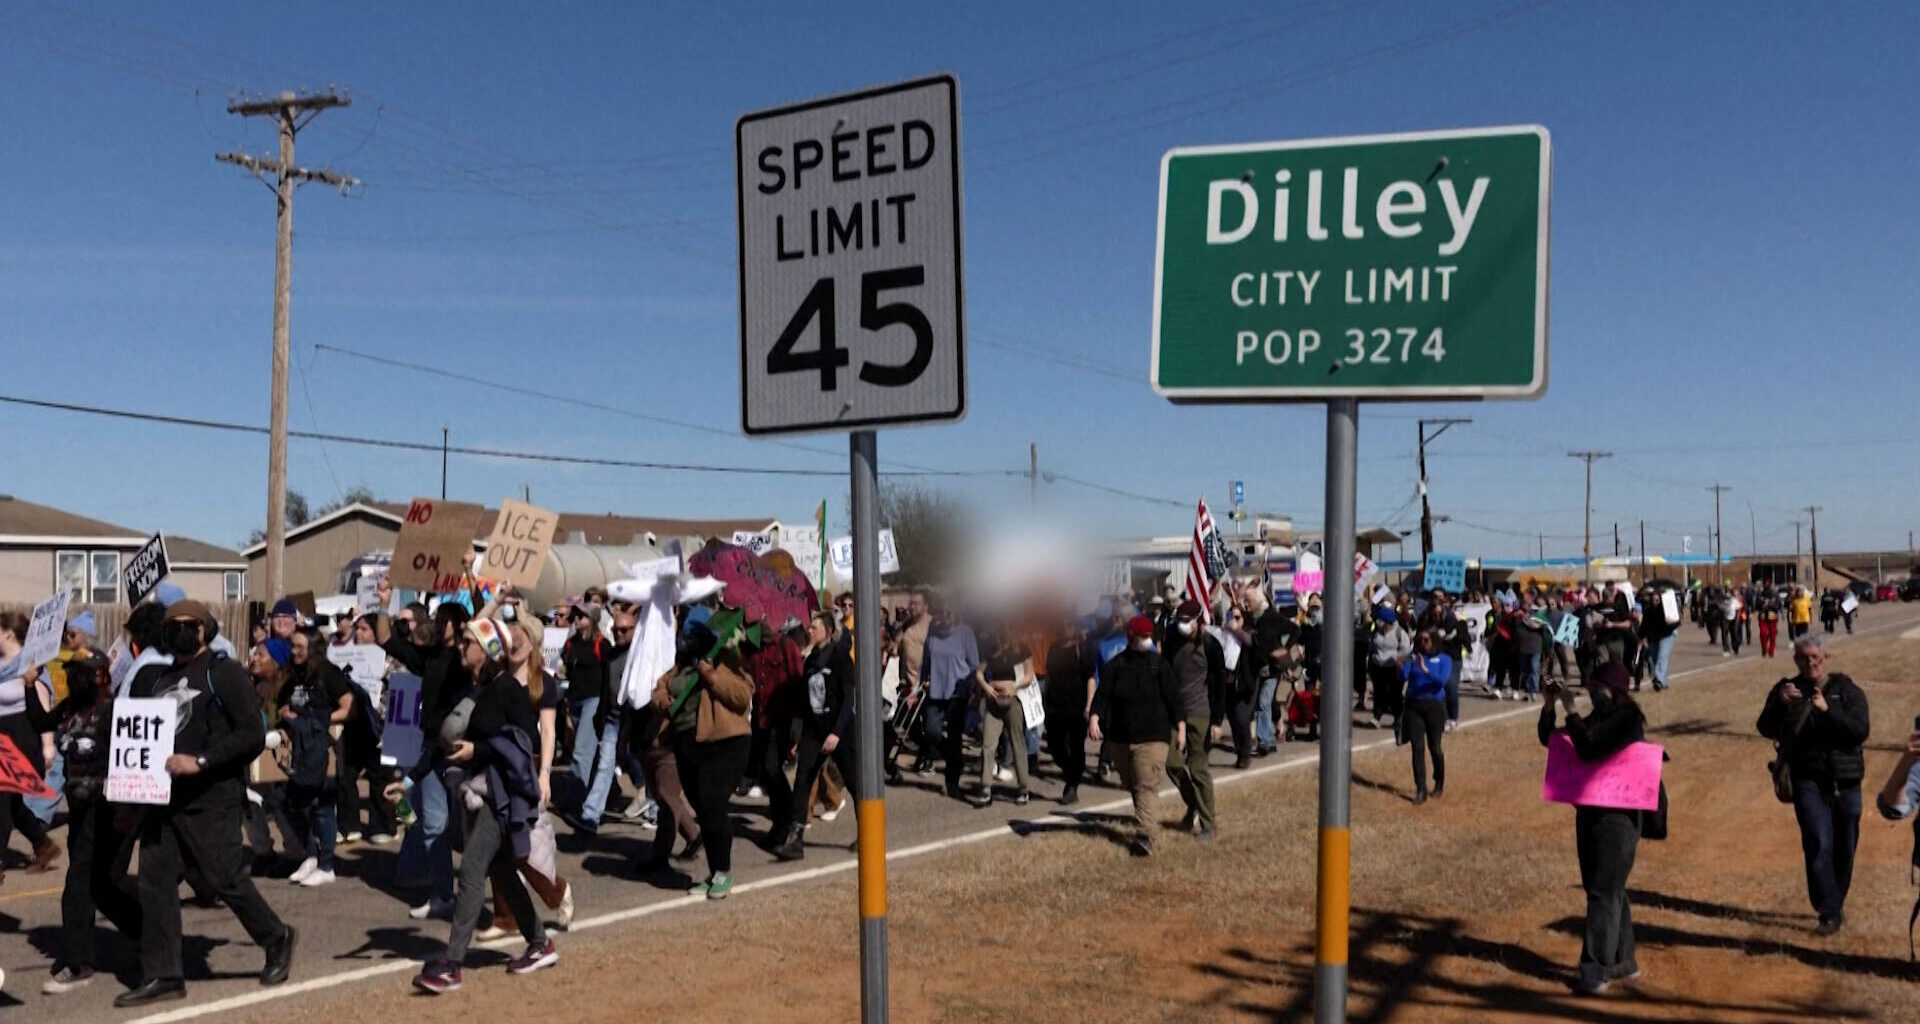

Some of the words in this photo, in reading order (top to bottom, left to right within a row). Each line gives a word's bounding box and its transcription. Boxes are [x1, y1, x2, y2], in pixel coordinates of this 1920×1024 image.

[758, 119, 935, 194] SPEED
[776, 193, 915, 262] LIMIT
[1206, 167, 1490, 255] Dilley
[1231, 270, 1321, 307] CITY
[1345, 266, 1458, 303] LIMIT
[767, 265, 933, 391] 45
[1236, 329, 1321, 365] POP
[1344, 327, 1446, 364] 3274
[406, 501, 433, 525] NO
[502, 510, 546, 543] ICE
[413, 552, 440, 575] ON
[488, 544, 537, 573] OUT
[136, 562, 159, 597] NOW
[115, 747, 150, 770] ICE
